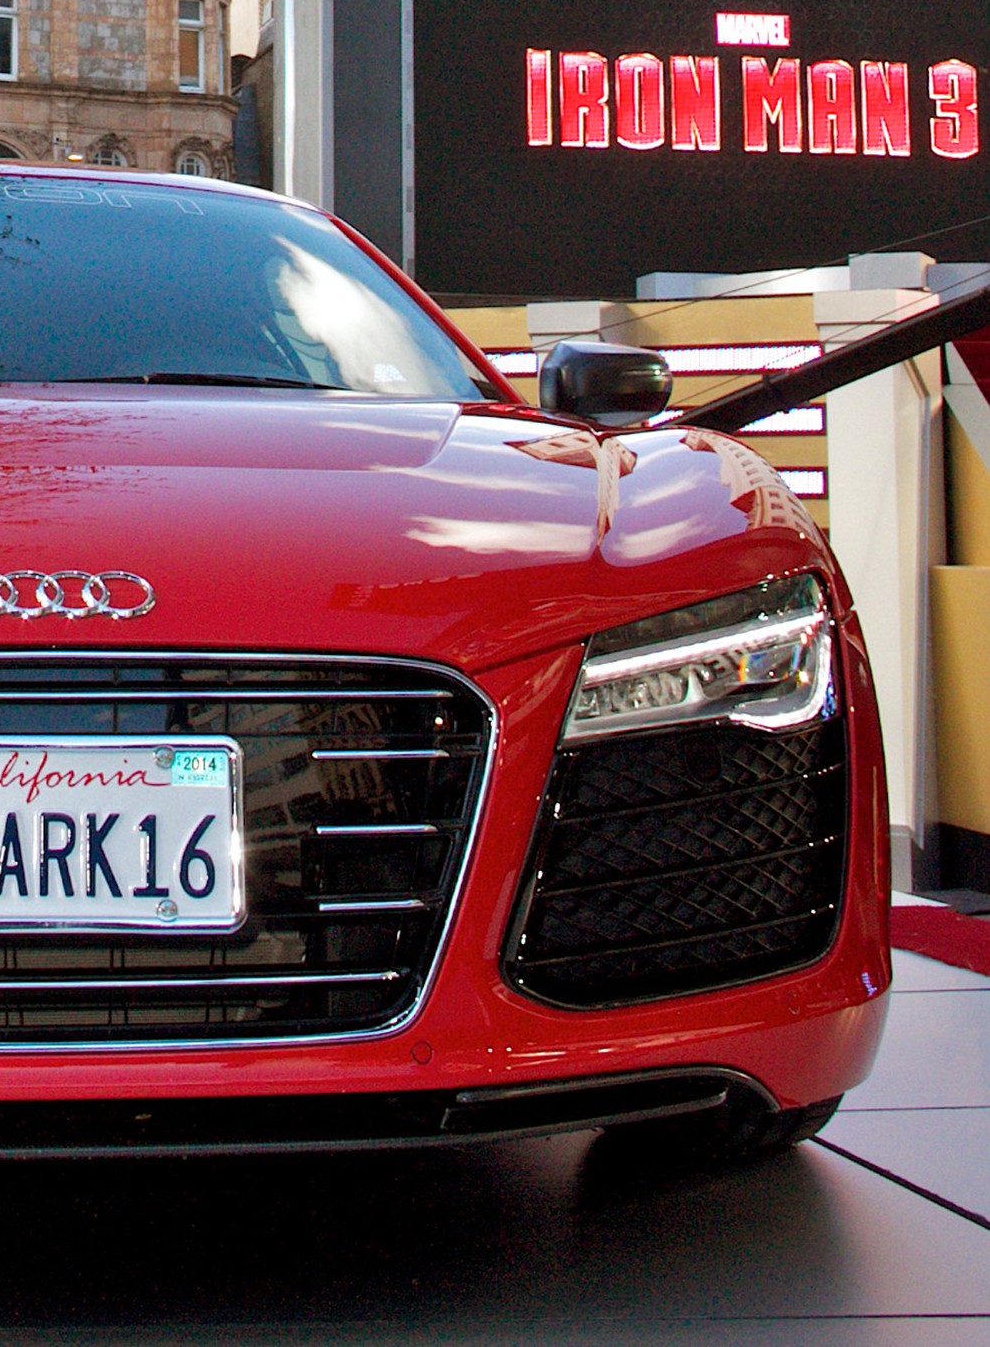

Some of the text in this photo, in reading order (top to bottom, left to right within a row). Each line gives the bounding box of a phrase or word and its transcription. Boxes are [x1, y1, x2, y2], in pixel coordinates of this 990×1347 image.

[716, 13, 790, 46] MARVEL
[526, 48, 979, 159] IRON MAN 3
[183, 756, 216, 772] 2014
